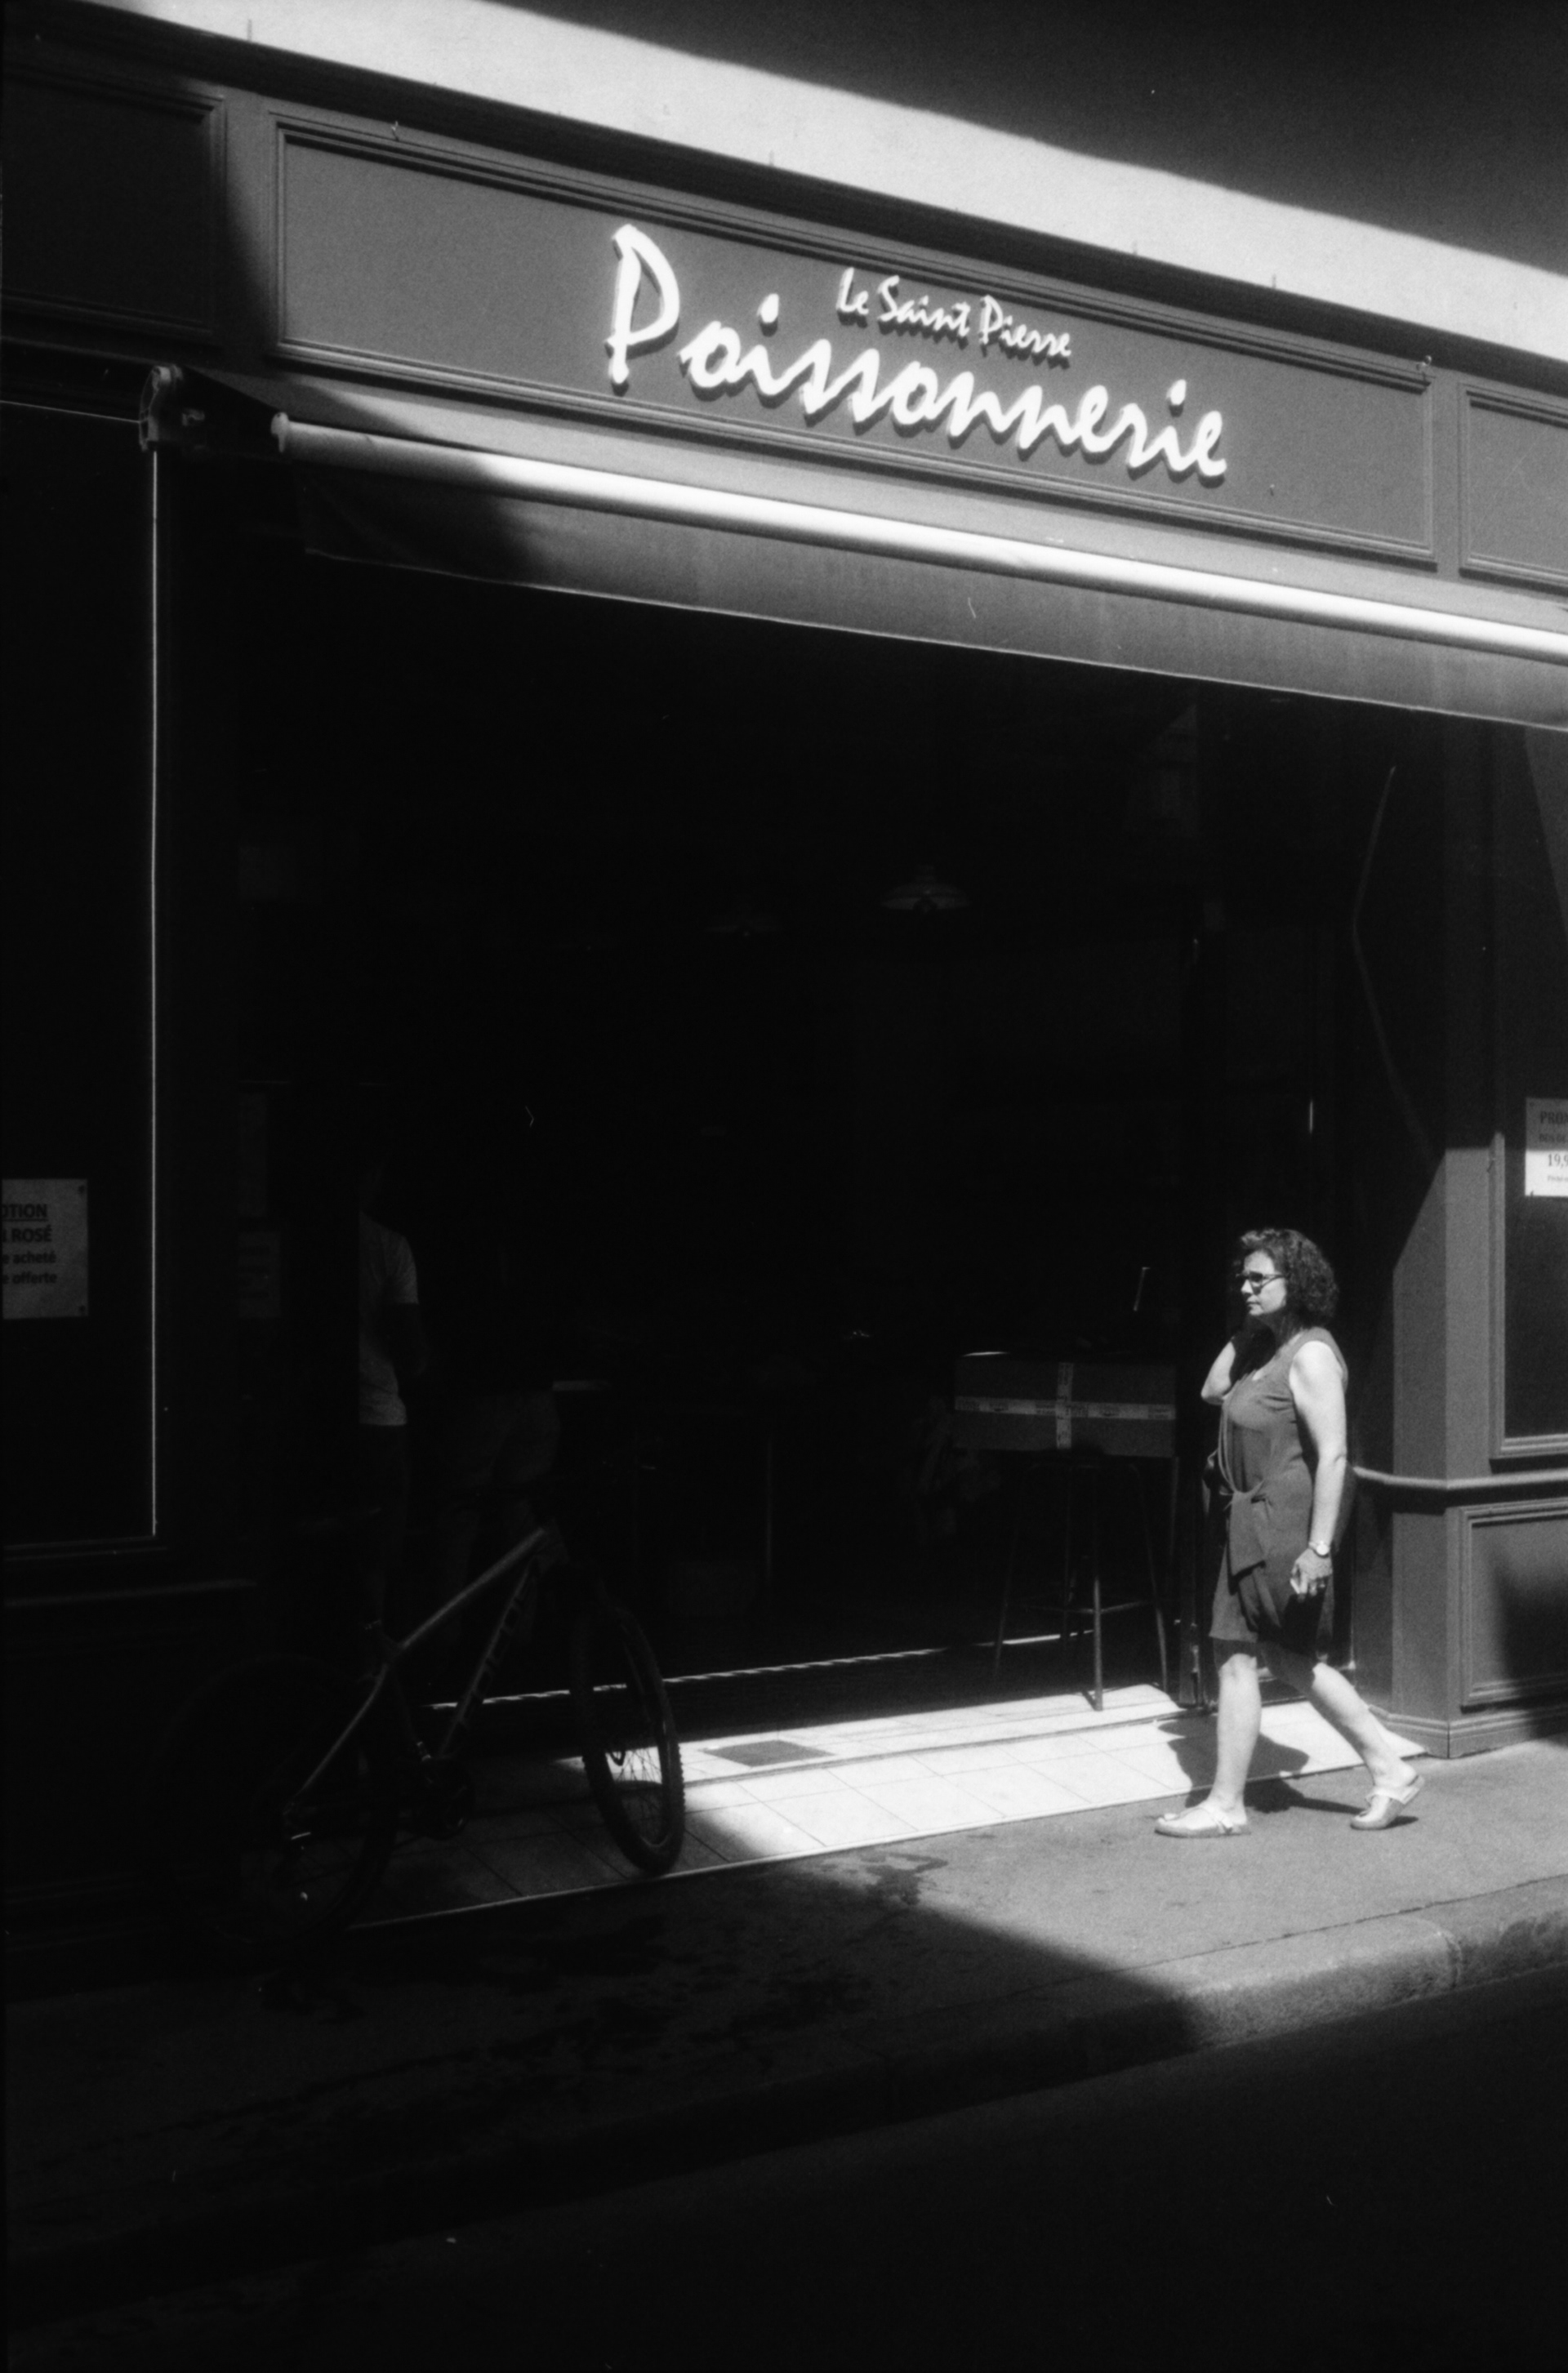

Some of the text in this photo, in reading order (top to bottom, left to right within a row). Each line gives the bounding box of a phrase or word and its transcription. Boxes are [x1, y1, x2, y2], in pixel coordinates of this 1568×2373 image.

[835, 267, 1072, 358] Le Saint Pierre
[605, 223, 1229, 477] Poissonnerie
[11, 1224, 52, 1242] ROSÉ
[13, 1250, 57, 1264] acheté
[12, 1271, 57, 1284] offerte
